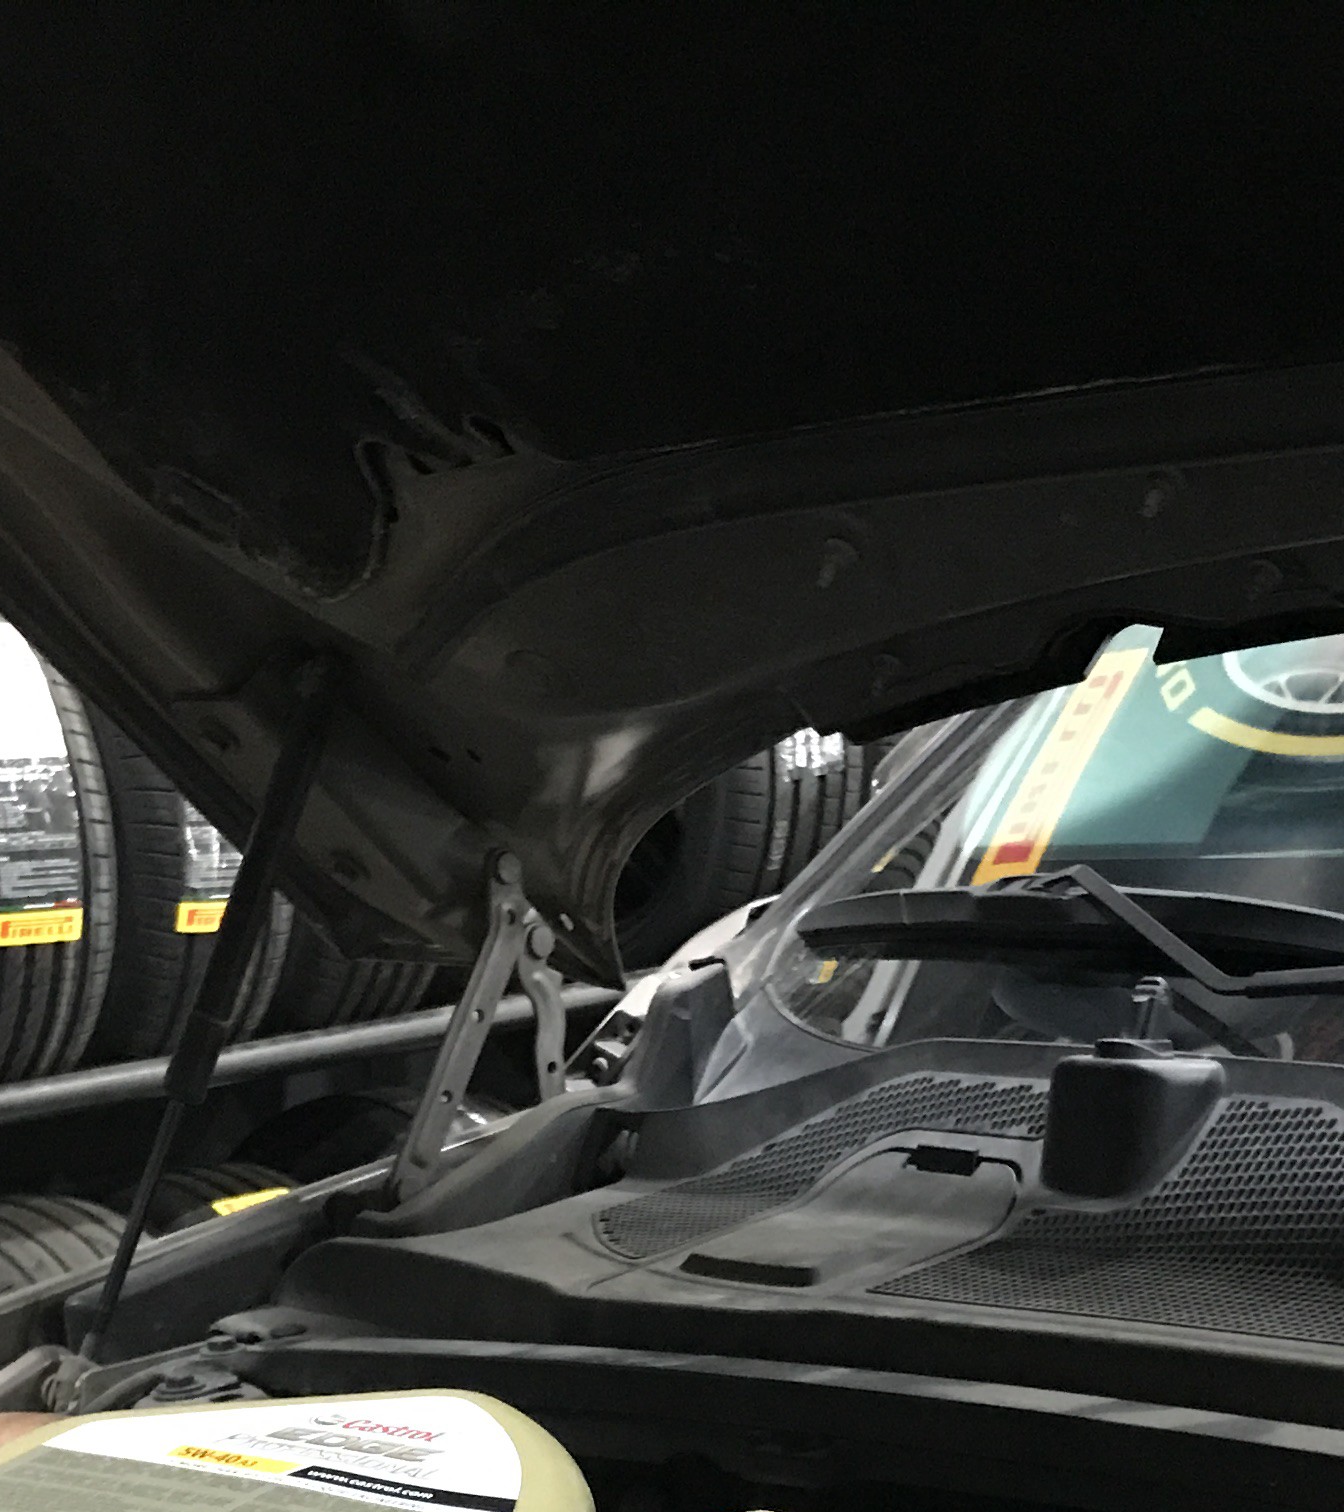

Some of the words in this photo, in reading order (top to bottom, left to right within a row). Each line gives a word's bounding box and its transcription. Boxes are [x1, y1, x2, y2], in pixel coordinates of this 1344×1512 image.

[266, 1426, 445, 1463] EDGE
[342, 1418, 444, 1443] Castrol
[307, 1469, 434, 1500] www.castrol.com
